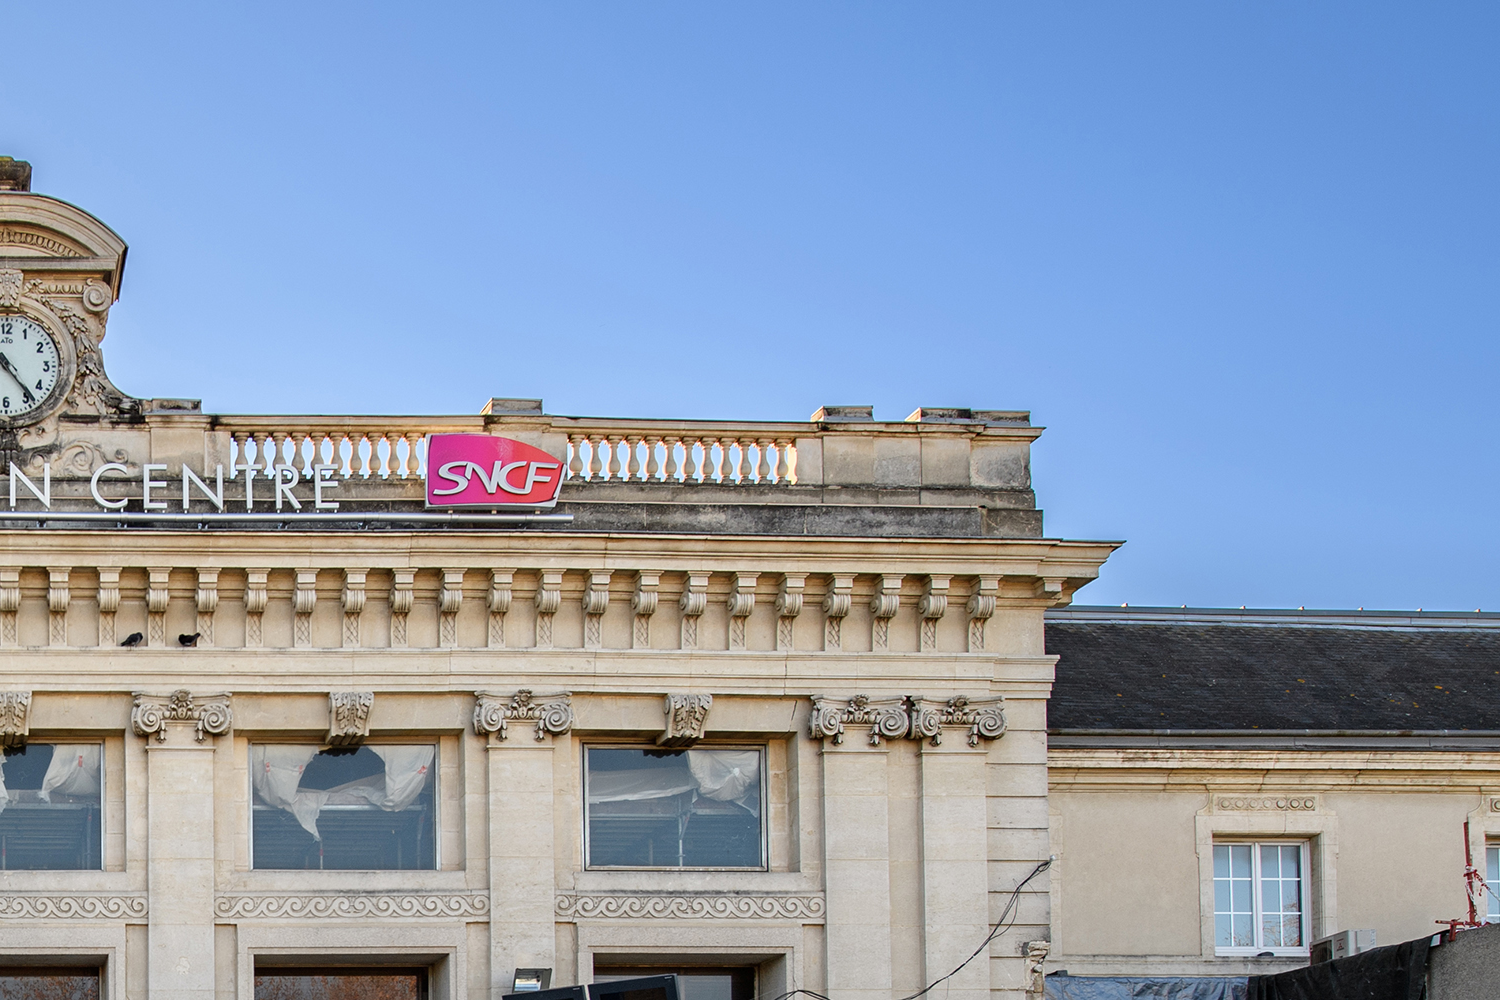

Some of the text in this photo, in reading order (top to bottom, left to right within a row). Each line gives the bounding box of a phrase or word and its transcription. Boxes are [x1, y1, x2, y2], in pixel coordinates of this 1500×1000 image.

[1, 323, 13, 334] 12
[22, 328, 27, 339] 1
[36, 342, 44, 353] 2
[43, 361, 50, 372] 3
[35, 379, 43, 390] 4
[3, 396, 10, 408] 6
[22, 392, 29, 404] 5
[433, 460, 562, 496] SNCF
[91, 463, 340, 510] CENTRE
